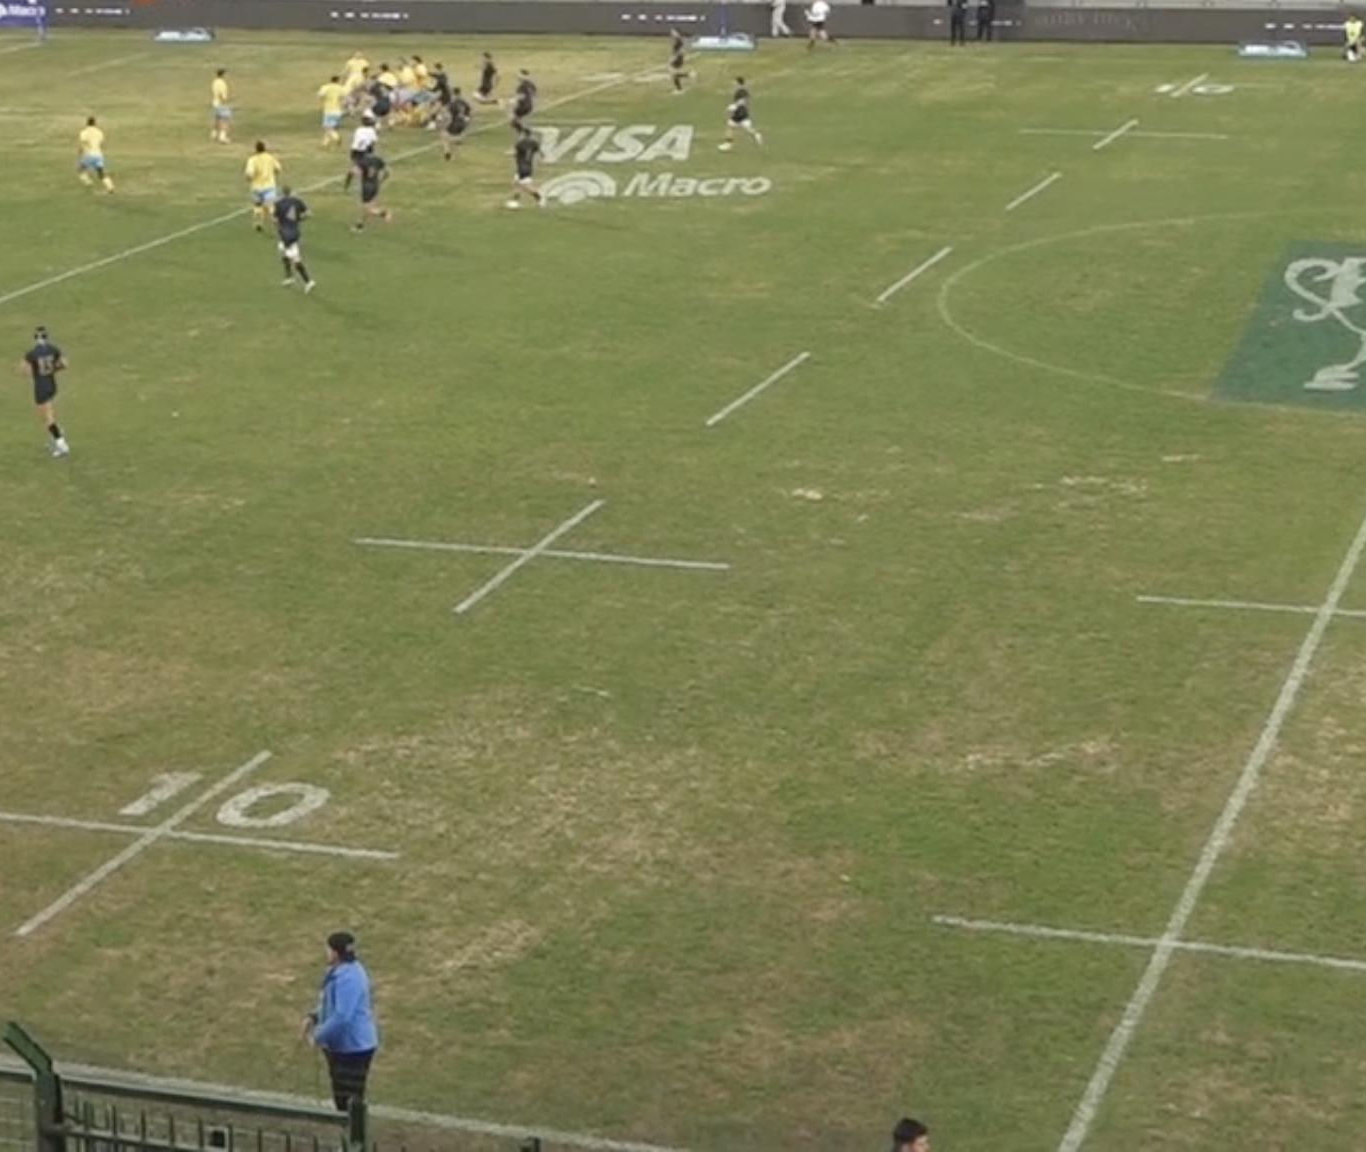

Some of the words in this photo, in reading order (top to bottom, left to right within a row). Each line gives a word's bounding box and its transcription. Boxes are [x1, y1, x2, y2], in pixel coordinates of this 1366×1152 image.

[533, 124, 693, 164] VISA
[624, 171, 772, 197] Macro
[117, 769, 331, 828] 10
